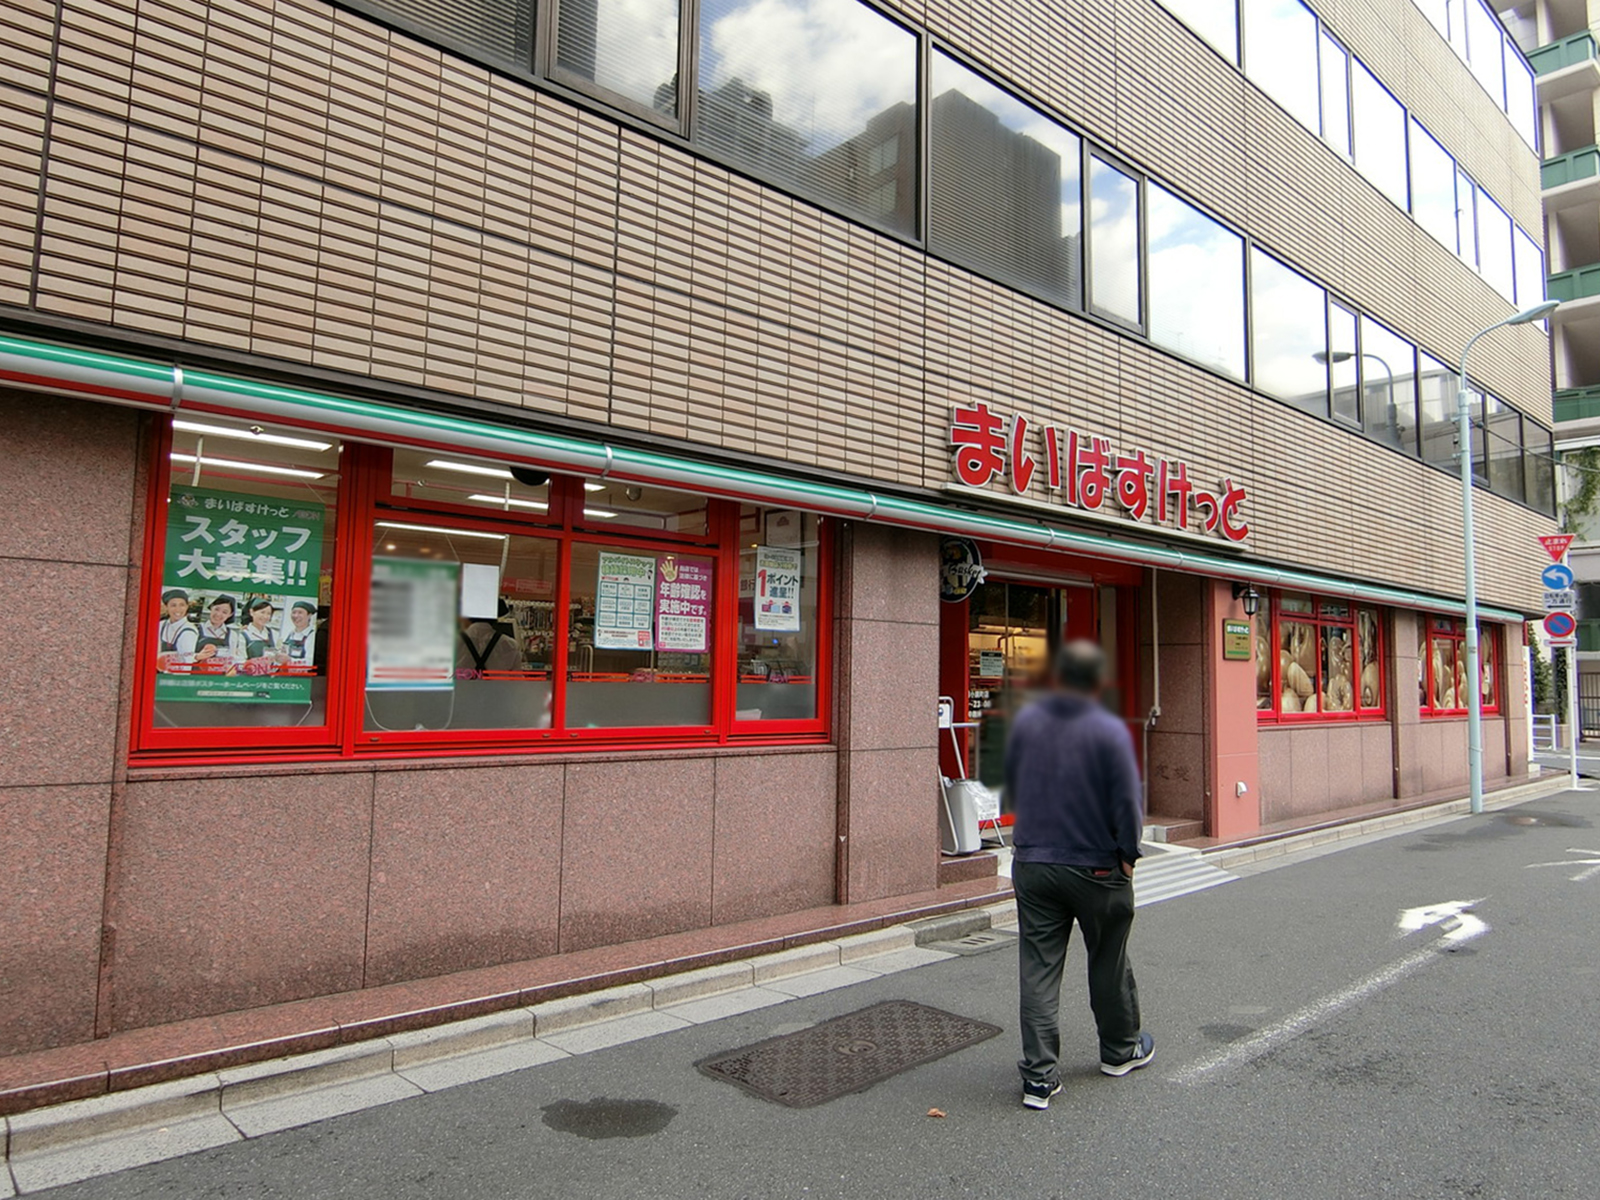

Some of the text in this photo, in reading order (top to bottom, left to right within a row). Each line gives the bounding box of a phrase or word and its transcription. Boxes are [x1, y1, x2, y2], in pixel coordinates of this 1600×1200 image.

[950, 401, 1250, 542] まいばすけっと
[204, 498, 290, 518] まいばすけっと
[180, 515, 312, 554] スタッフ
[176, 548, 308, 586] 大募集!!
[767, 572, 799, 586] ポイント
[660, 582, 707, 600] 年齢確認を
[659, 599, 707, 615] 実施中です。
